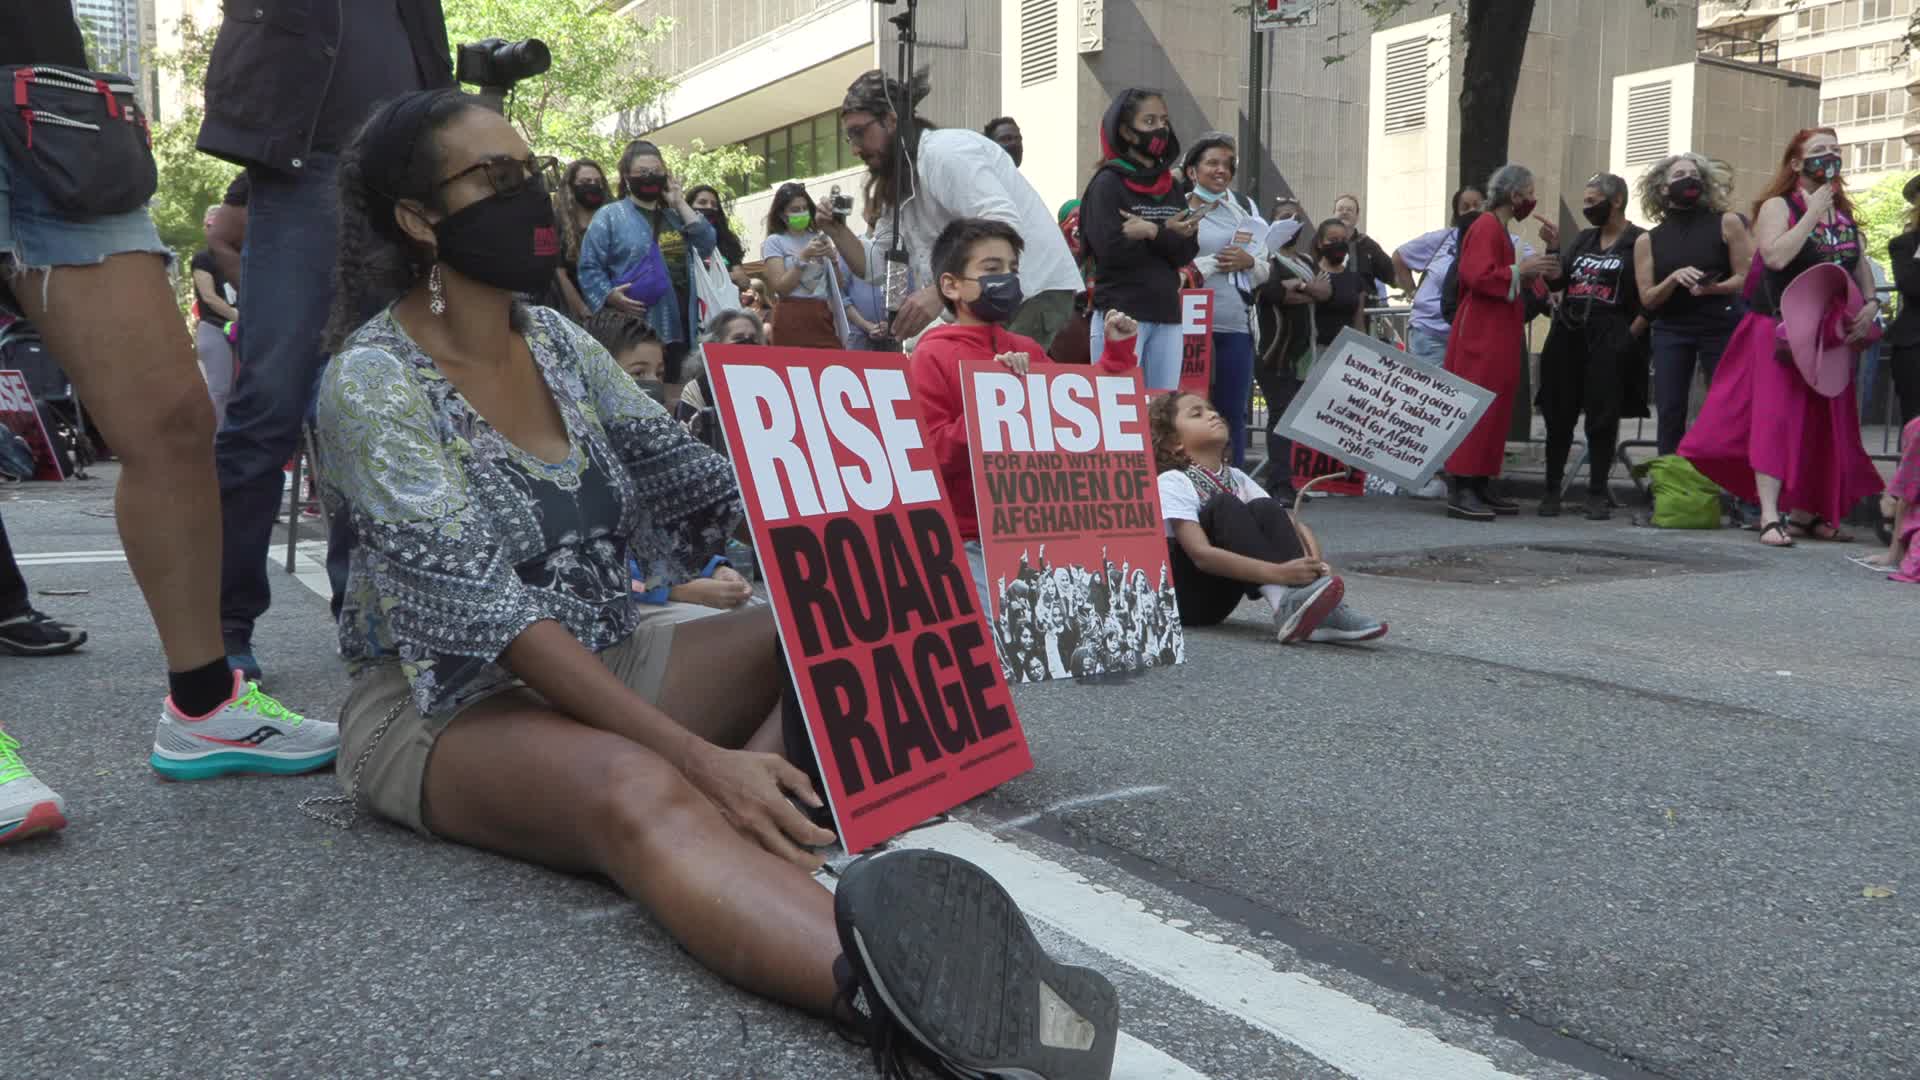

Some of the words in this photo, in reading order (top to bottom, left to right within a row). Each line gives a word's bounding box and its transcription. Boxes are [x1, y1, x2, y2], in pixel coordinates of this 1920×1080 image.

[1345, 354, 1392, 385] banned
[1390, 375, 1418, 397] from
[1418, 393, 1453, 416] going
[1453, 407, 1467, 420] to
[1378, 356, 1400, 371] My
[1400, 366, 1431, 385] mom
[1431, 380, 1459, 397] was
[974, 372, 1144, 452] RISE
[1327, 399, 1335, 410] I
[1334, 406, 1370, 427] stand
[1368, 420, 1386, 435] for
[1384, 430, 1428, 454] Afghan
[1348, 394, 1369, 410] will
[1366, 405, 1389, 420] not
[1381, 390, 1397, 407] by
[1445, 420, 1454, 431] I
[722, 364, 941, 520] RISE
[983, 454, 1021, 470] FOR
[1026, 454, 1063, 470] AND
[1066, 453, 1110, 469] WITH
[1112, 453, 1148, 468] THE
[1338, 437, 1375, 460] rights
[1366, 438, 1424, 466] education
[985, 470, 1110, 504] WOMEN
[1114, 469, 1151, 501] OF
[1295, 448, 1361, 484] RA
[992, 502, 1155, 535] AFGHANISTAN
[769, 508, 974, 657] ROAR
[809, 623, 1011, 796] RAGE
